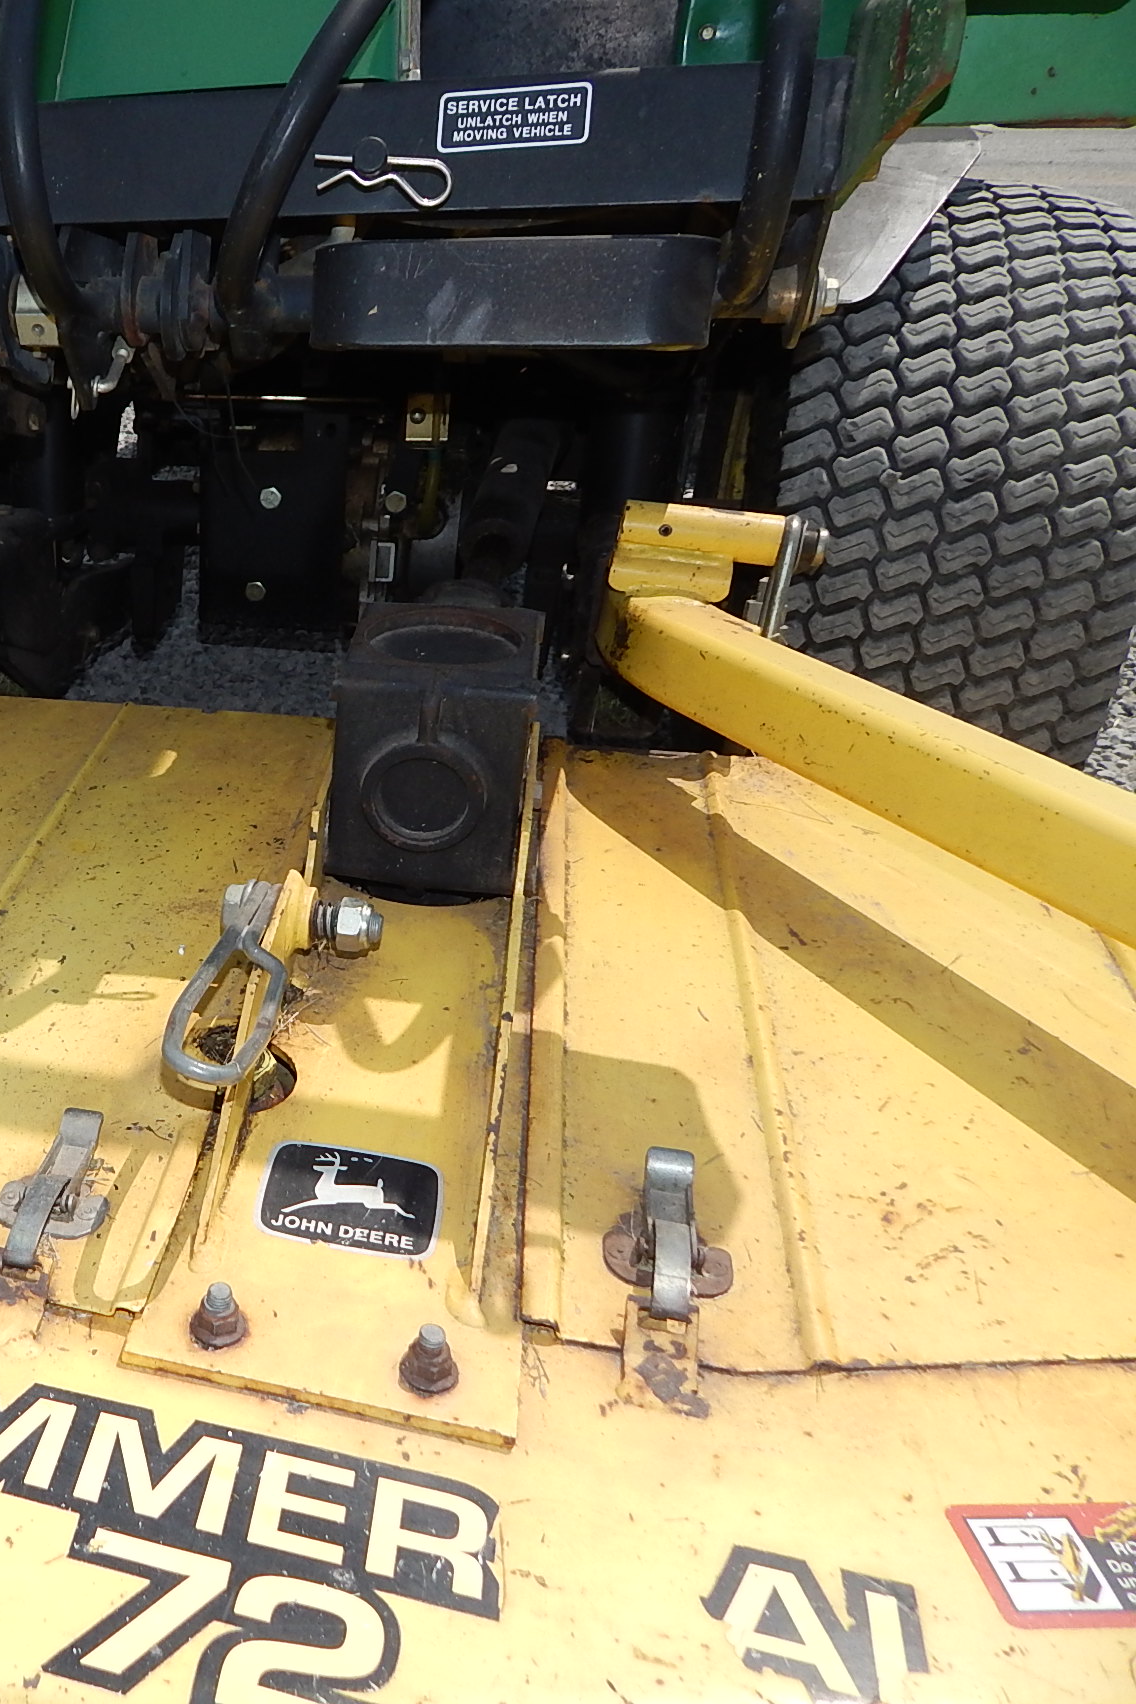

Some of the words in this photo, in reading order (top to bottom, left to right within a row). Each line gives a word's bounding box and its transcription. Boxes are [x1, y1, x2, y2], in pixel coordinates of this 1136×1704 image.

[447, 97, 518, 115] SERVICE
[525, 93, 582, 110] LATCH
[457, 113, 522, 128] UNLATCH
[527, 111, 568, 124] WHEN
[452, 127, 507, 142] MOVING
[513, 124, 573, 138] VEHICLE
[270, 1214, 332, 1235] JOHN
[338, 1225, 414, 1250] DEERE
[42, 1512, 402, 1704] 72
